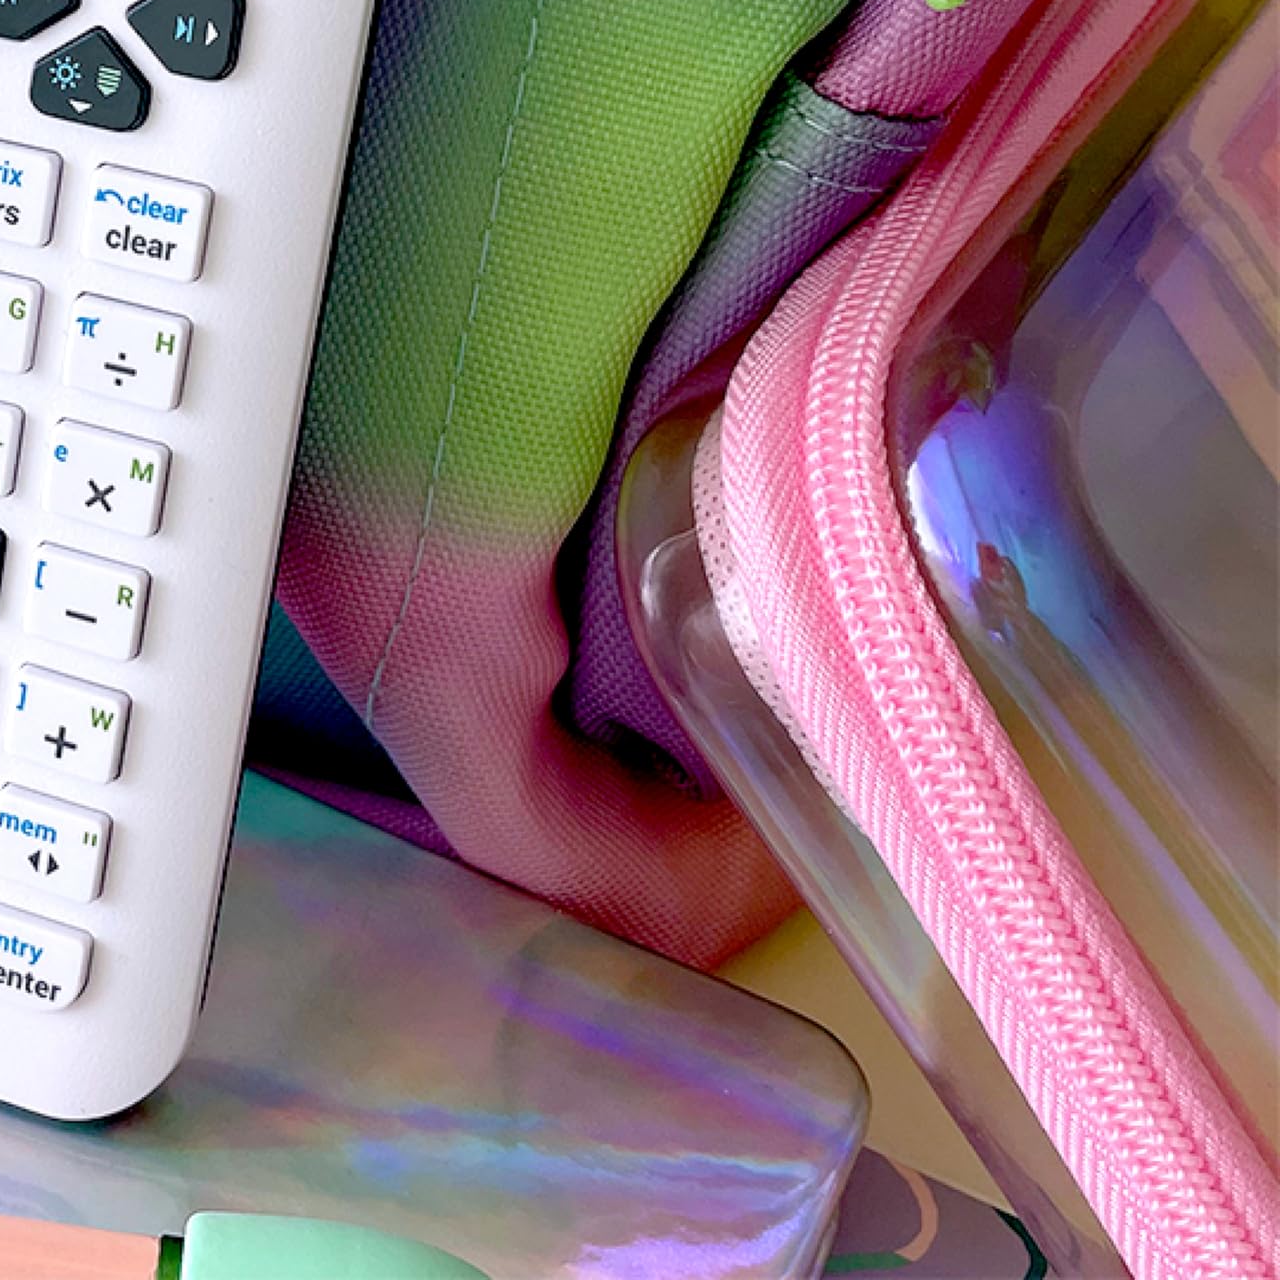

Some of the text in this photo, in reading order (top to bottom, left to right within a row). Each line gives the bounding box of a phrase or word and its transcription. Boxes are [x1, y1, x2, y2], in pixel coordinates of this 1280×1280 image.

[126, 192, 189, 225] clear
[105, 225, 177, 261] clear
[9, 298, 26, 320] G
[76, 316, 101, 337] π
[154, 332, 175, 356] H
[53, 444, 69, 463] e
[129, 458, 155, 484] M
[34, 559, 48, 590] [
[117, 584, 134, 609] R
[16, 682, 28, 712] ]
[91, 706, 114, 732] W
[44, 726, 77, 759] +
